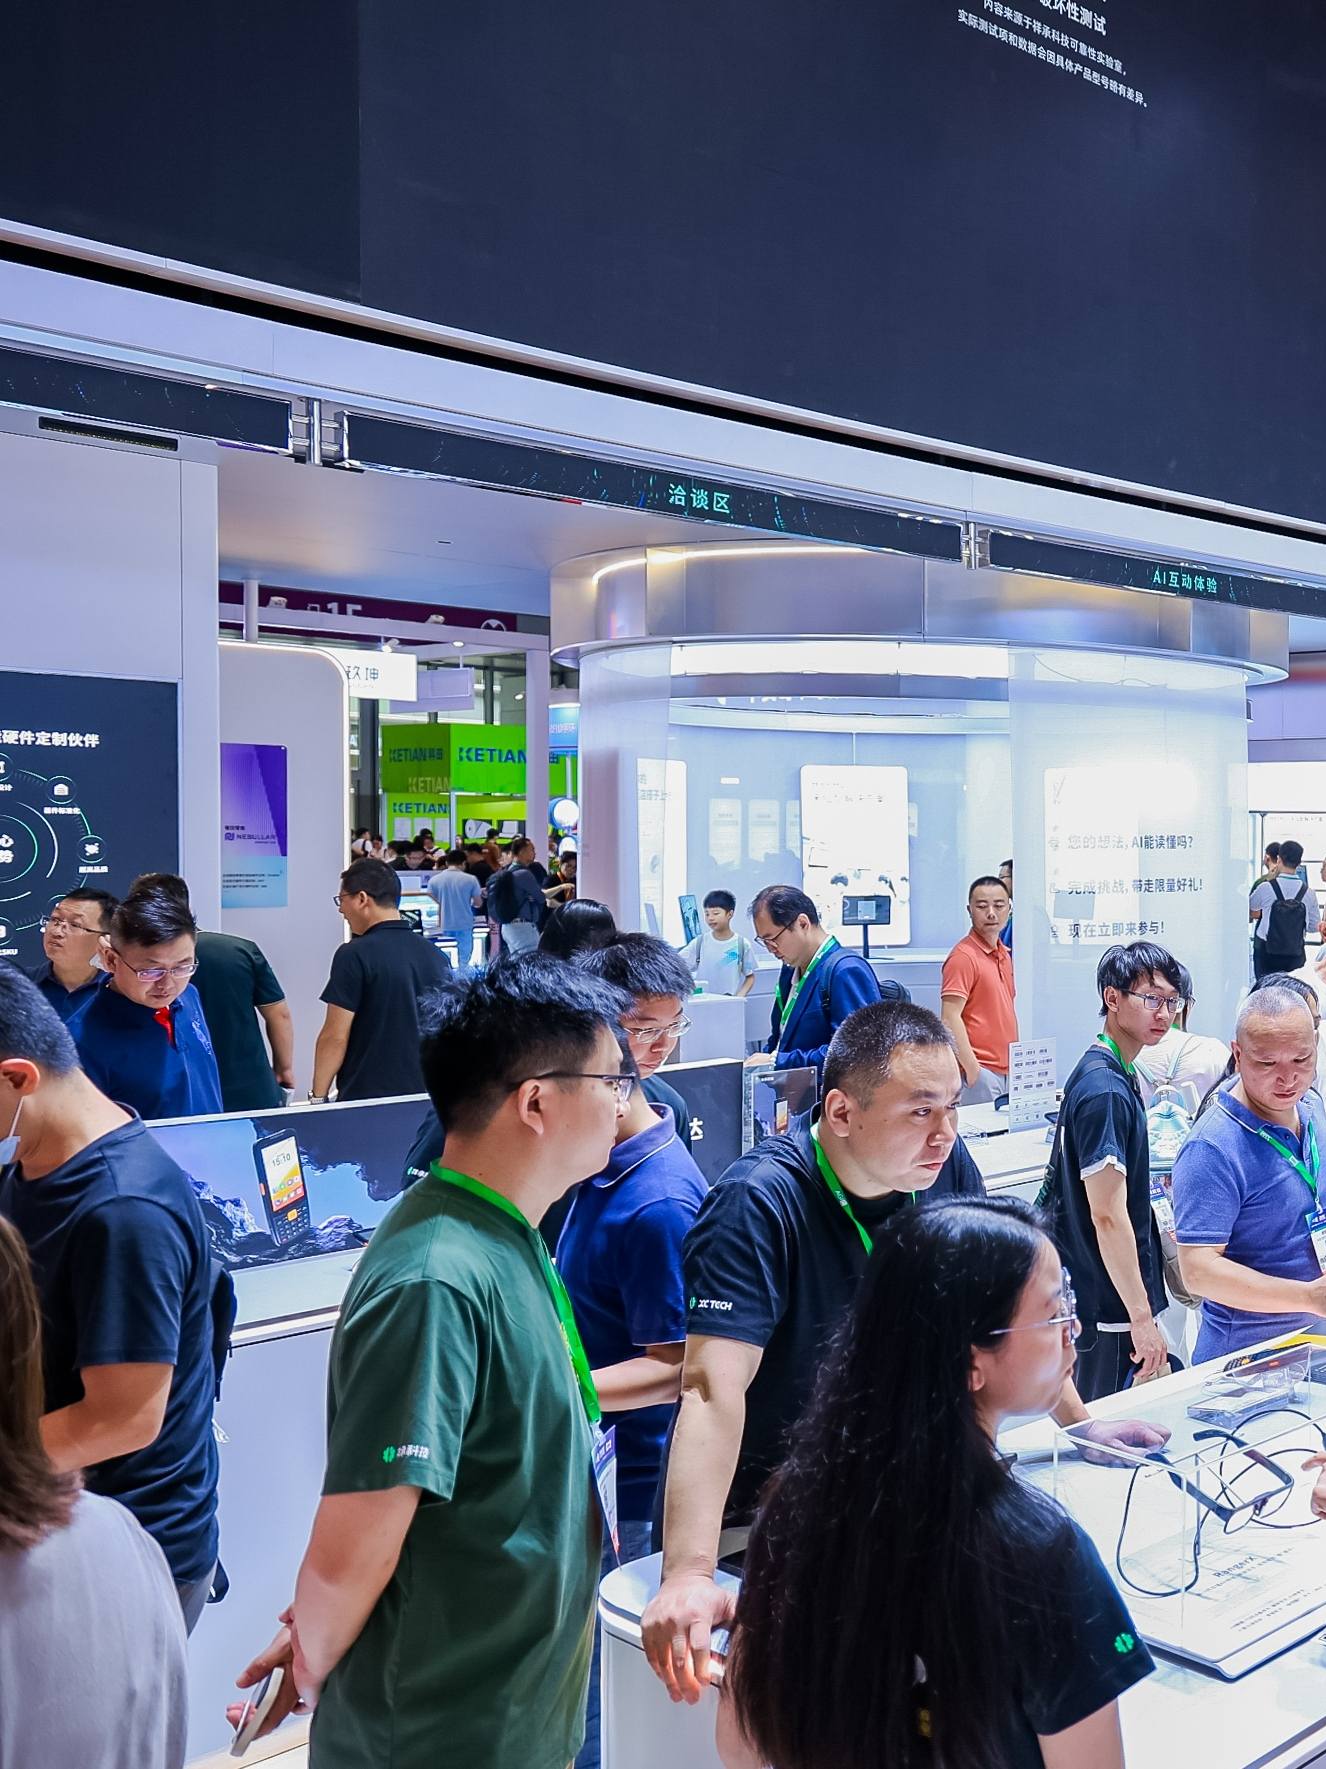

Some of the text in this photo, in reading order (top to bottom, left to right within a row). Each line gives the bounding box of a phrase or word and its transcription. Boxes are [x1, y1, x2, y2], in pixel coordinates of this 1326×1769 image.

[668, 483, 731, 514] 洽谈区
[1152, 569, 1218, 594] AI互动体验
[710, 1300, 733, 1311] TECH
[1213, 1556, 1257, 1578] RangerX
